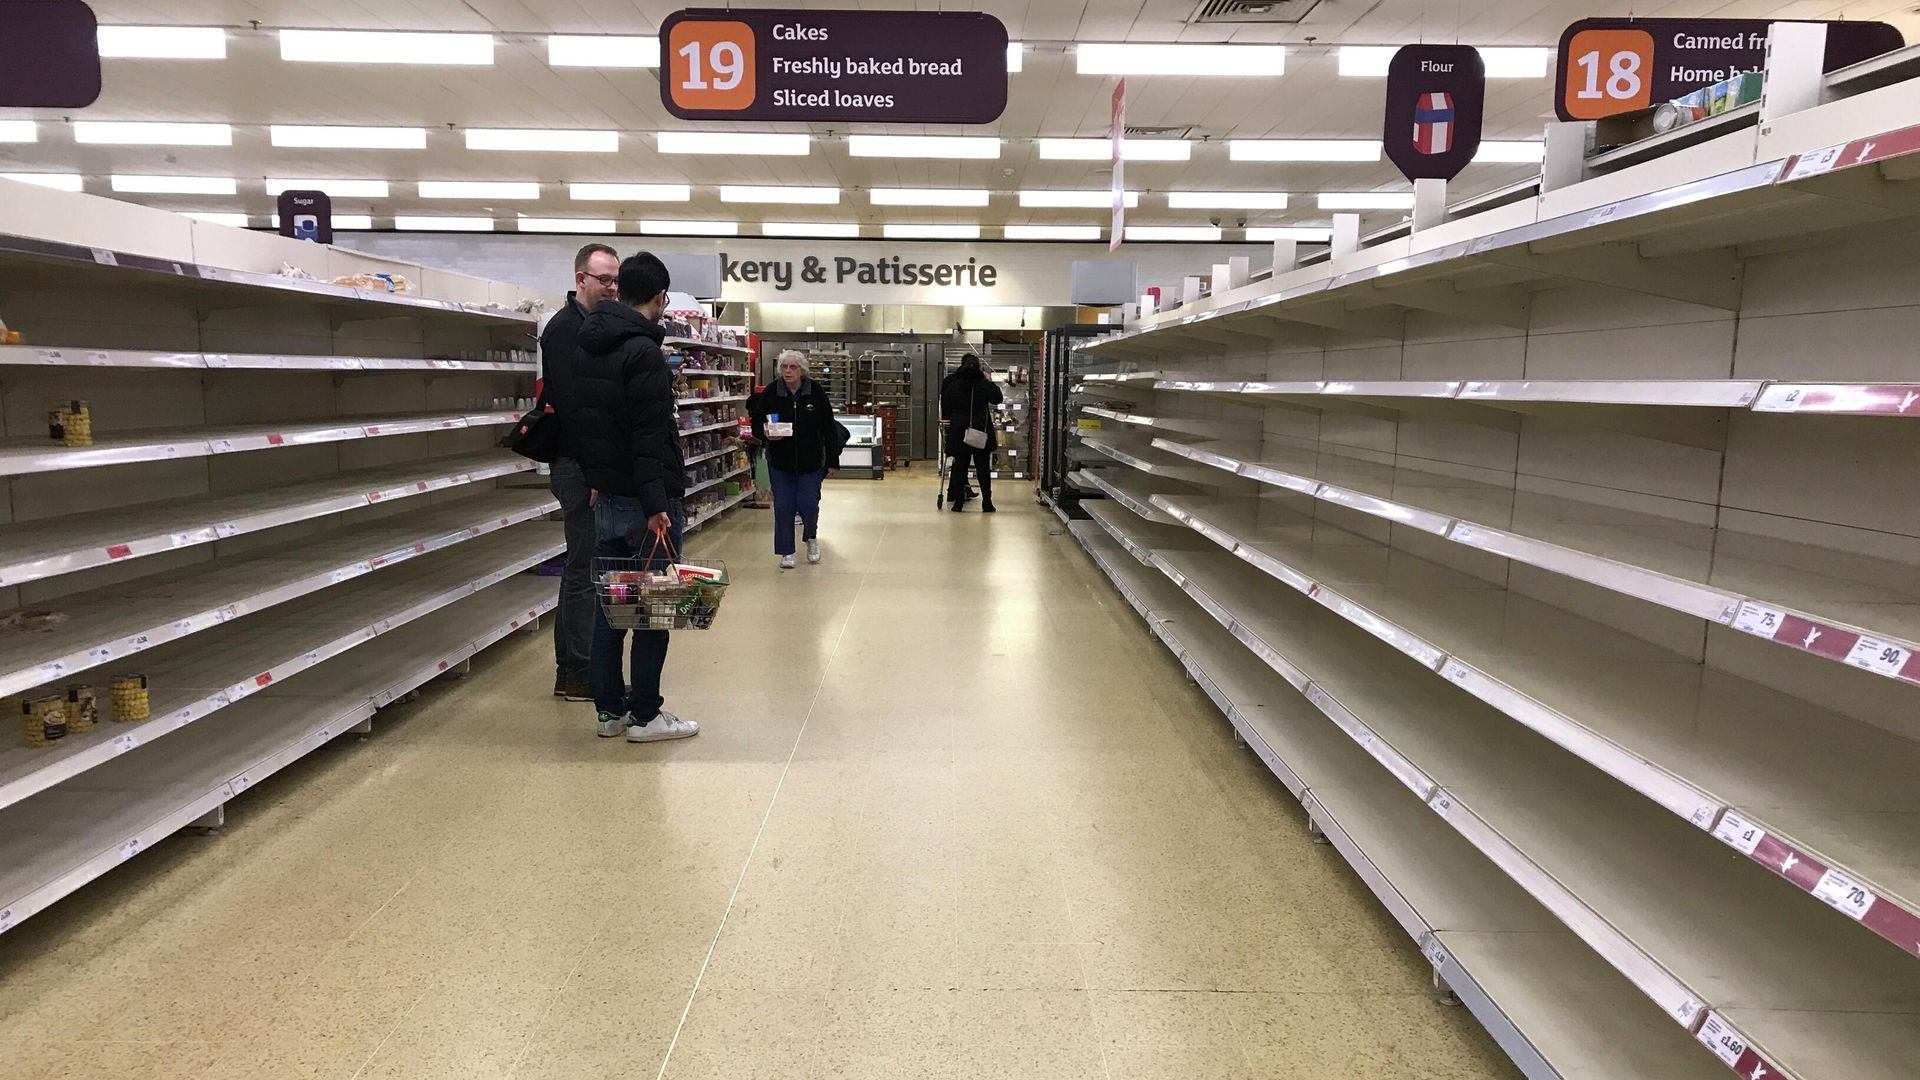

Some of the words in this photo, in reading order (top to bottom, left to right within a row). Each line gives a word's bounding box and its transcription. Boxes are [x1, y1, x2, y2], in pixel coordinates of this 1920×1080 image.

[772, 24, 828, 41] Cakes
[1673, 32, 1744, 50] Canned
[678, 41, 744, 91] 19
[772, 57, 841, 78] Freshly
[846, 57, 904, 75] baked
[908, 58, 962, 76] bread
[1420, 60, 1455, 73] Flour
[1576, 50, 1641, 99] 18
[1670, 66, 1725, 82] Home
[773, 89, 830, 107] Sliced
[834, 90, 894, 108] loaves
[293, 197, 314, 206] Sugar
[719, 252, 792, 291] kery
[800, 255, 827, 283] &
[834, 255, 998, 287] Patisserie
[1742, 829, 1755, 842] £1
[1720, 1035, 1743, 1056] £1.60
